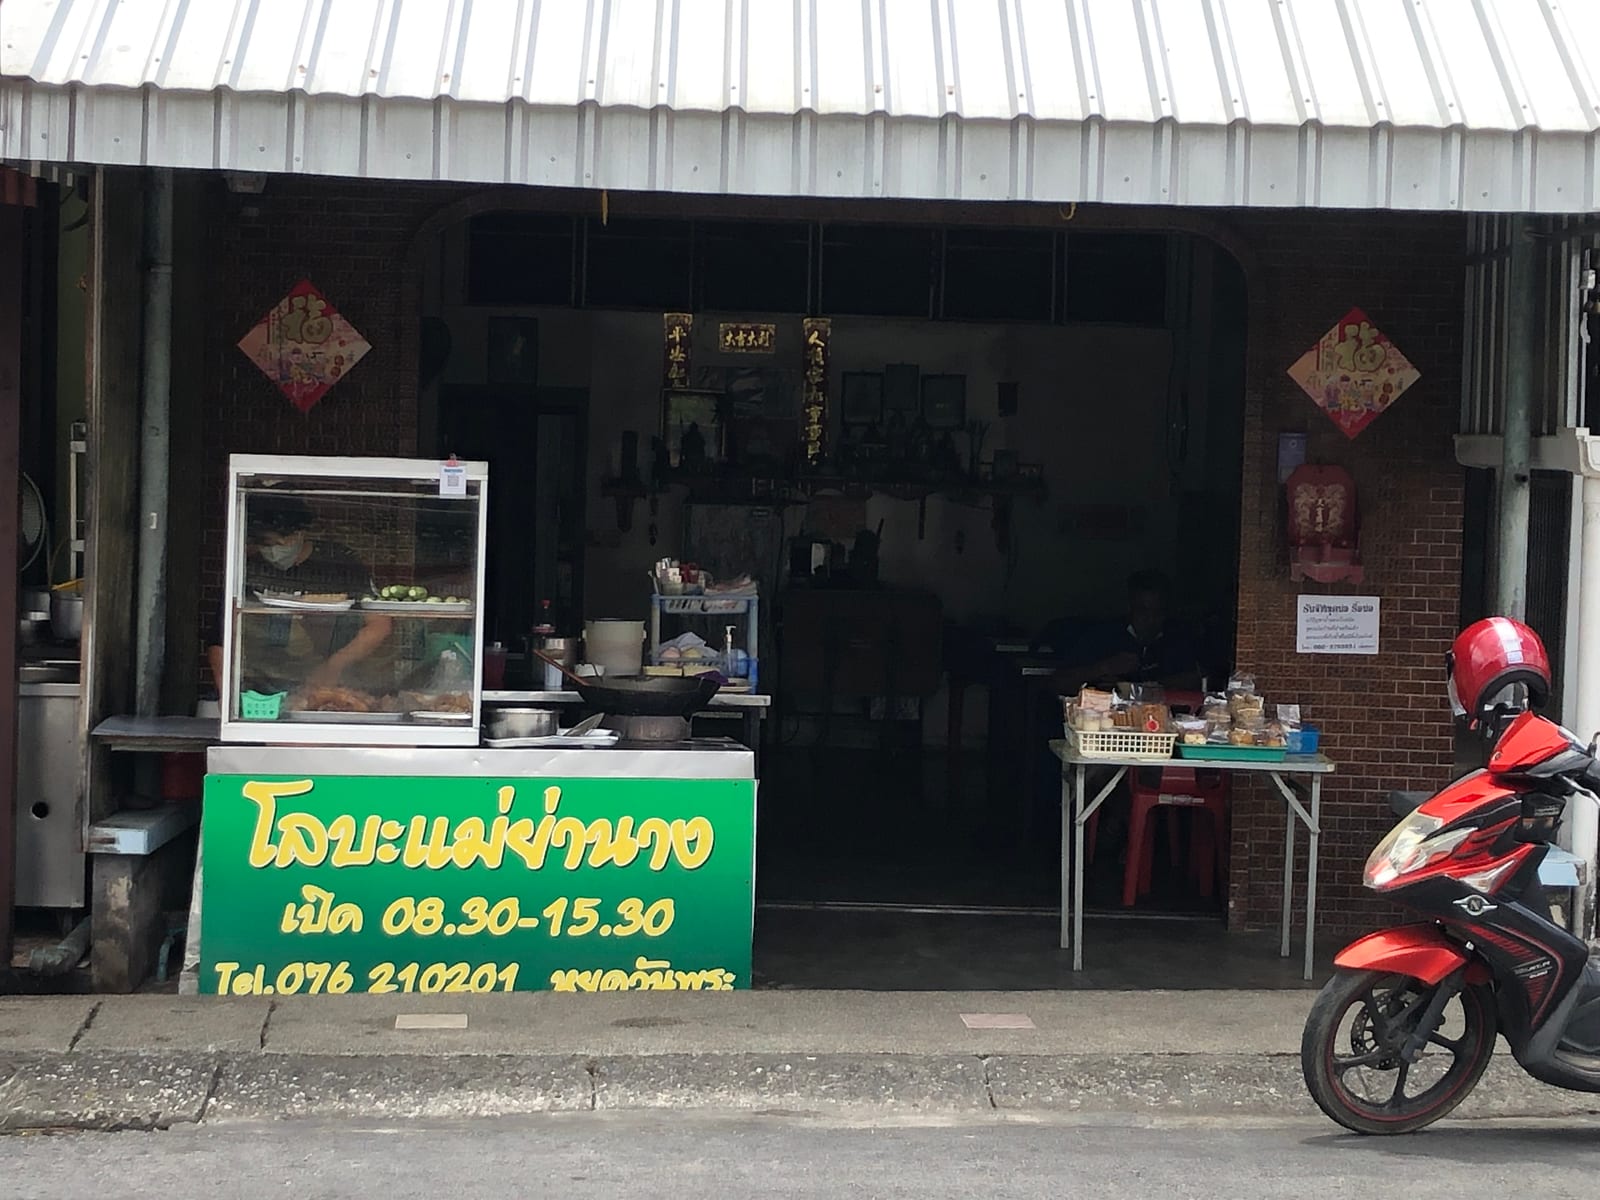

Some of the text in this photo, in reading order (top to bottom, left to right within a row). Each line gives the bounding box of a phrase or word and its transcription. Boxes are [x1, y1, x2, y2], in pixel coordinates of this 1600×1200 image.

[724, 330, 770, 348] 大吉大利
[243, 780, 714, 870] โลบะแม่ย่านาง
[281, 884, 675, 936] เปิด 08.30-15.30
[215, 956, 736, 995] Tel.076 210201 หยดวันพระ
